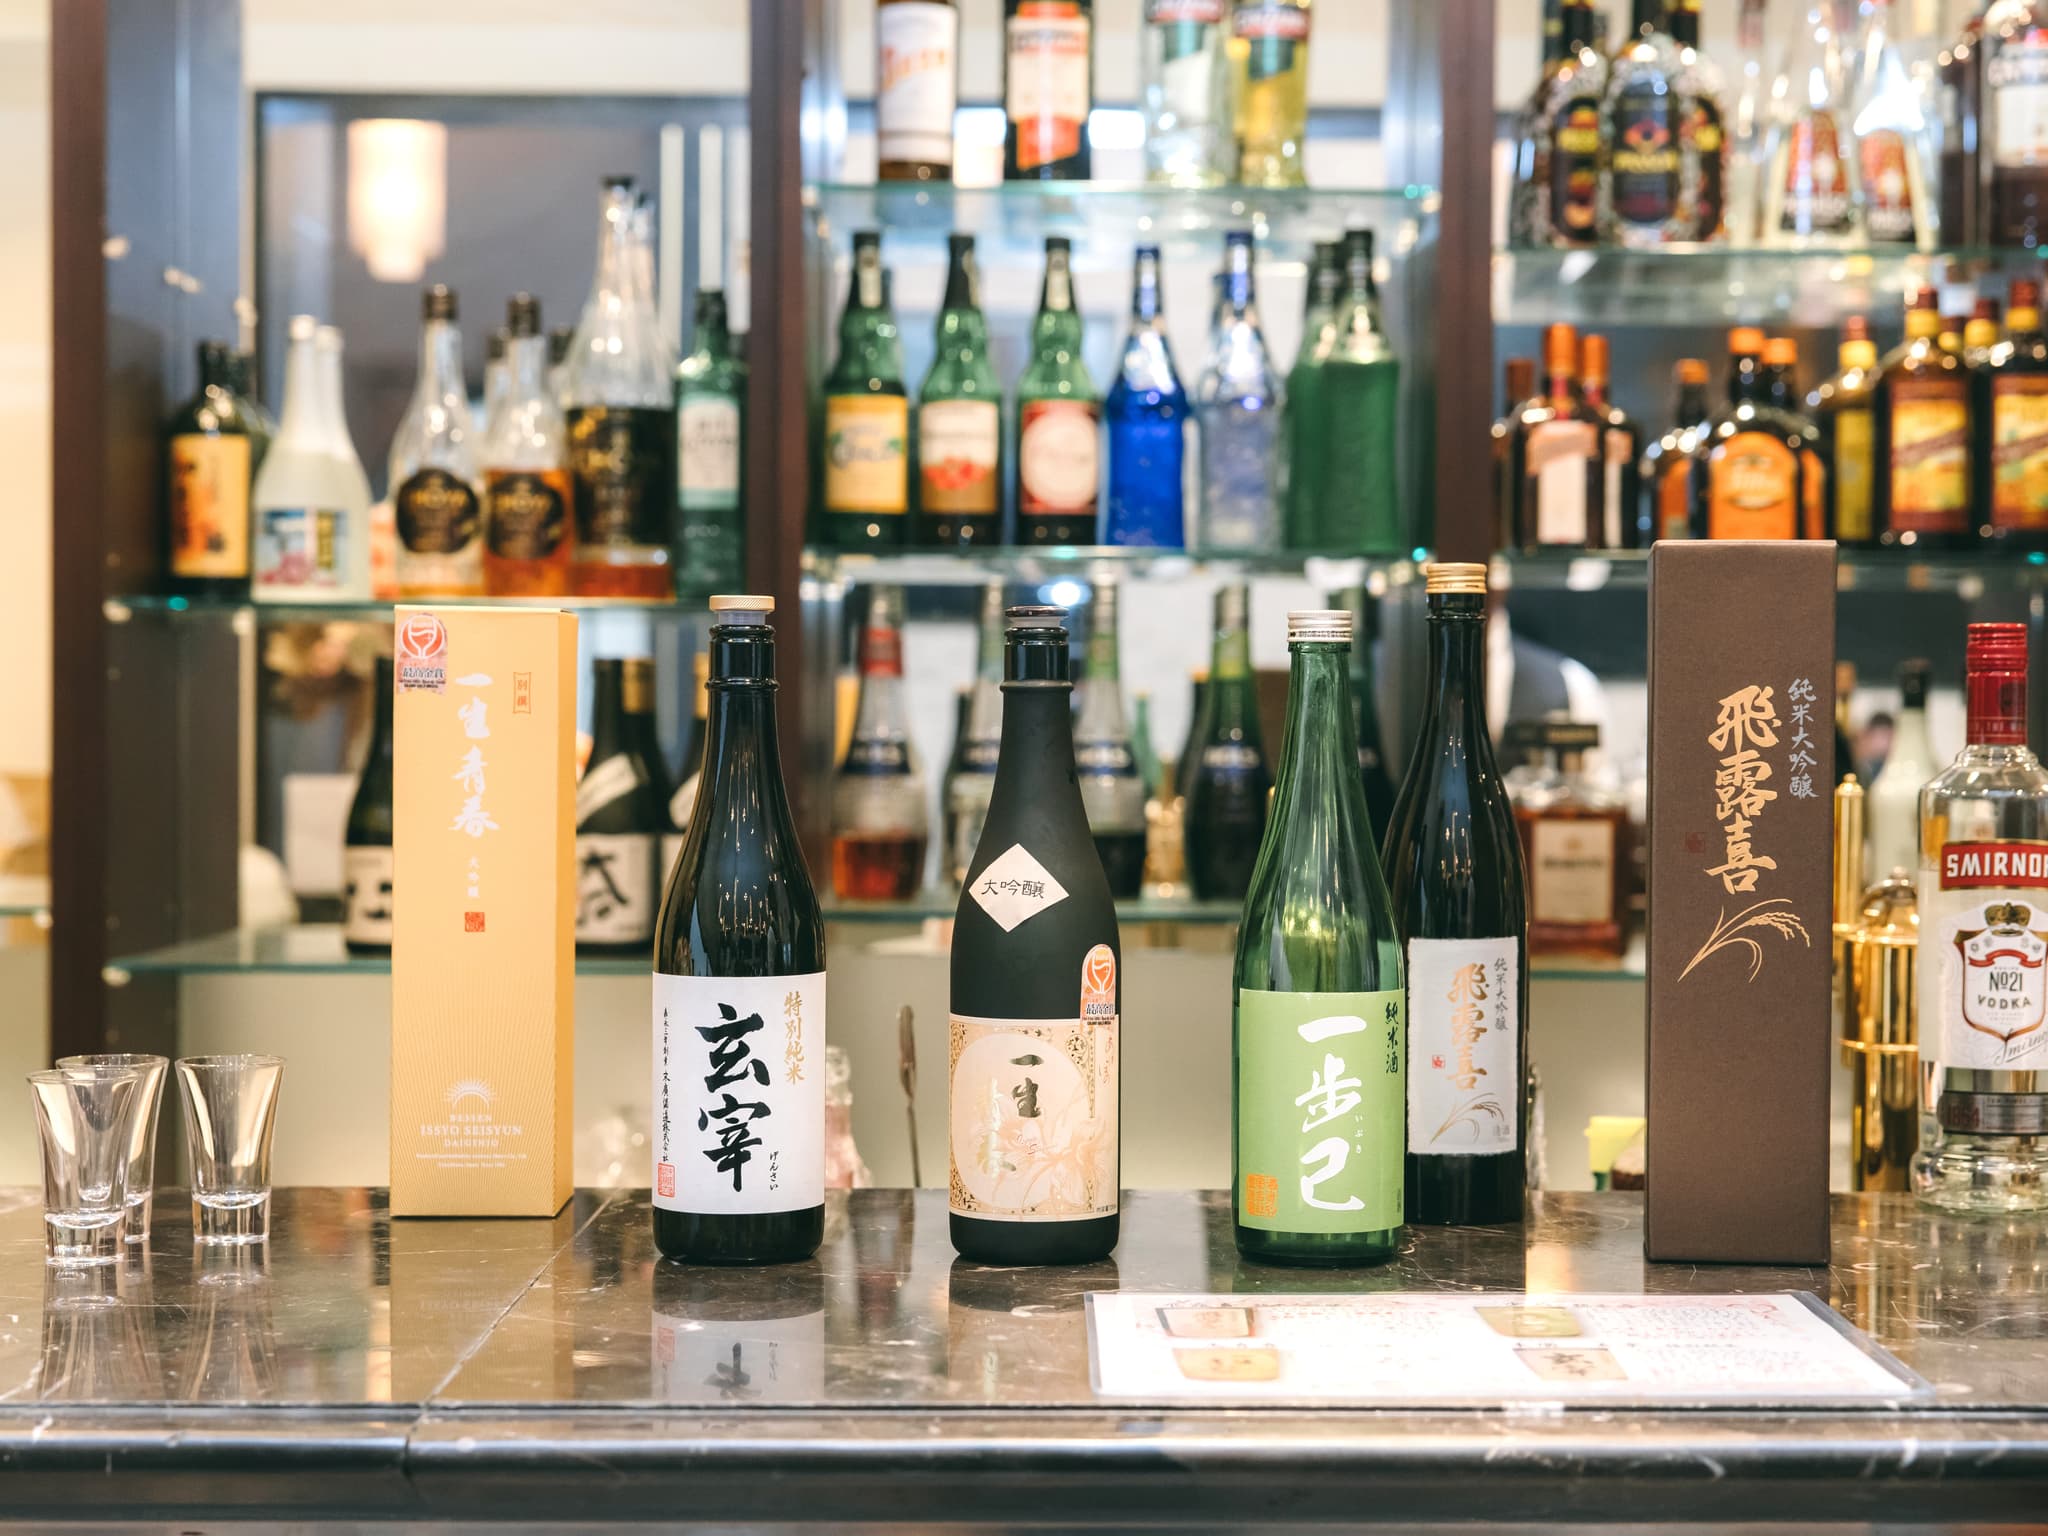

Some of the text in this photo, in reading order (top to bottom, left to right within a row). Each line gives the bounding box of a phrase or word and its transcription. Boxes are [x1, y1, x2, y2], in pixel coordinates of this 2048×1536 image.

[1703, 684, 1782, 895] 飛露喜
[1787, 678, 1819, 800] 純米大吟醸
[981, 878, 1045, 899] 大吟醸
[784, 991, 805, 1085] 特別純米
[1385, 1001, 1399, 1074] 純米酒
[1447, 962, 1490, 1091] 飛露喜
[1977, 995, 2032, 1009] VODKA
[1295, 1015, 1367, 1211] 一歩己
